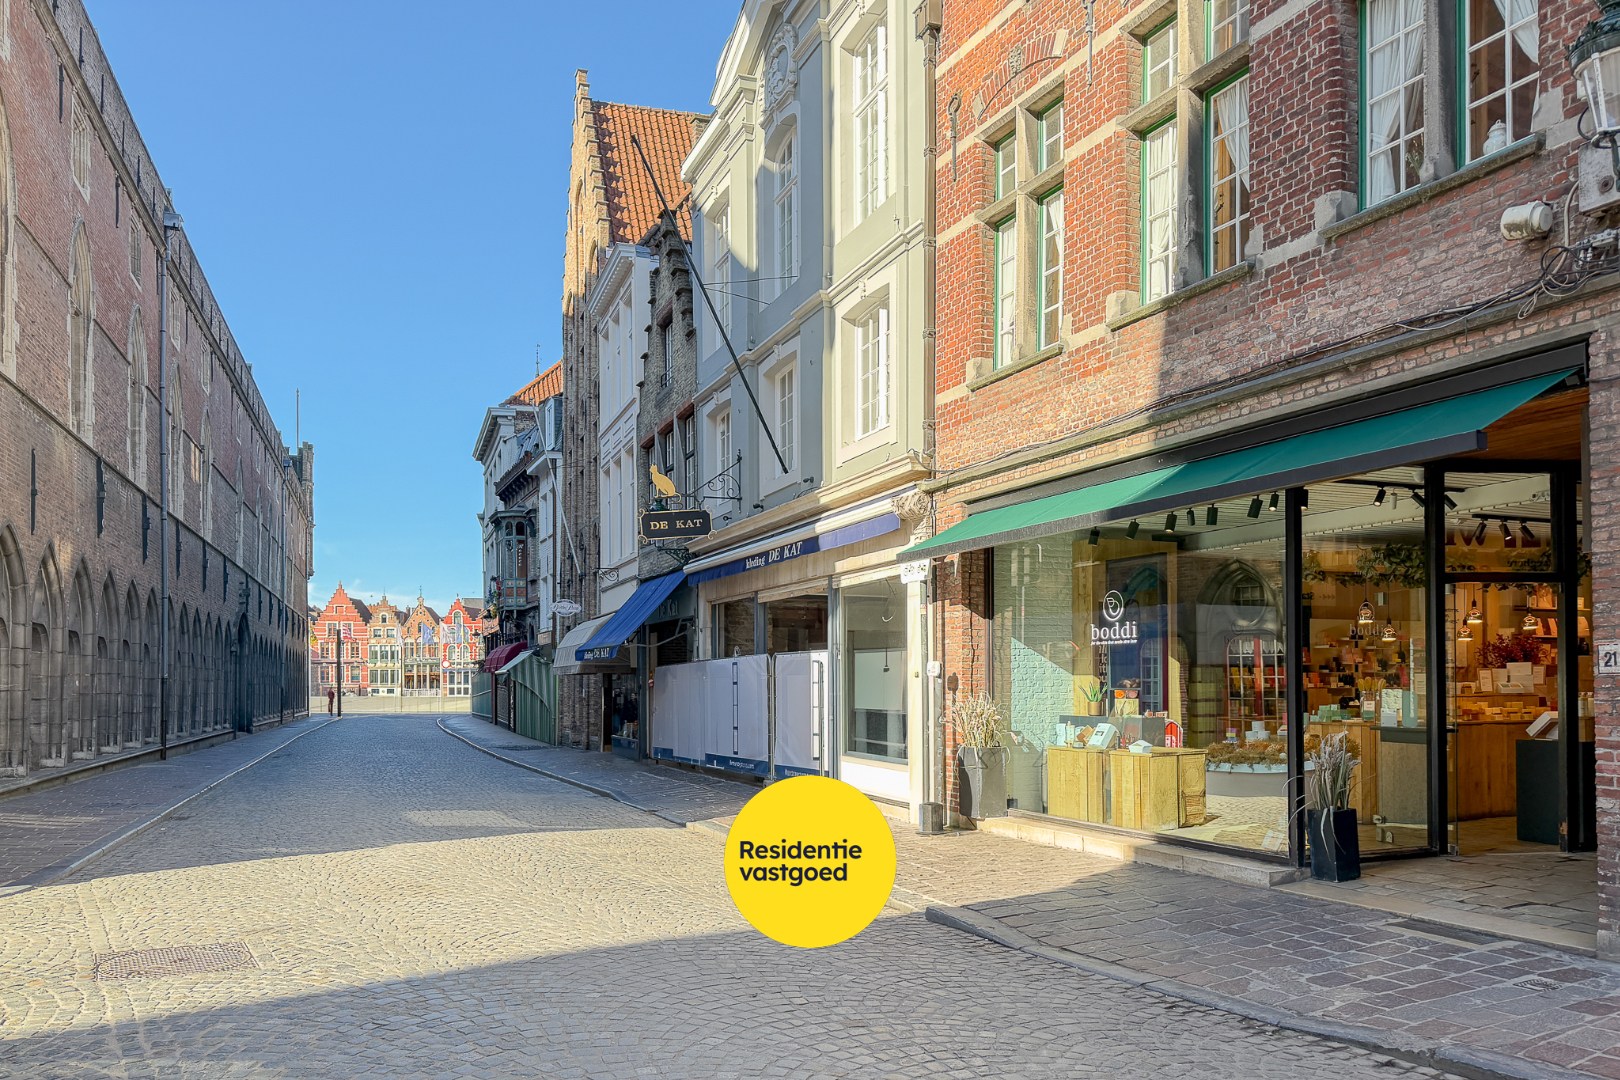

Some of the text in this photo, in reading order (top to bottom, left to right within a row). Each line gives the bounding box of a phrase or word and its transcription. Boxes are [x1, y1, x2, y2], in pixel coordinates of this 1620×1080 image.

[650, 519, 703, 530] DE KAT
[768, 548, 781, 563] DE
[784, 541, 803, 559] KAT
[1090, 621, 1138, 640] boddi
[601, 647, 610, 658] KAT
[1603, 651, 1618, 668] 21
